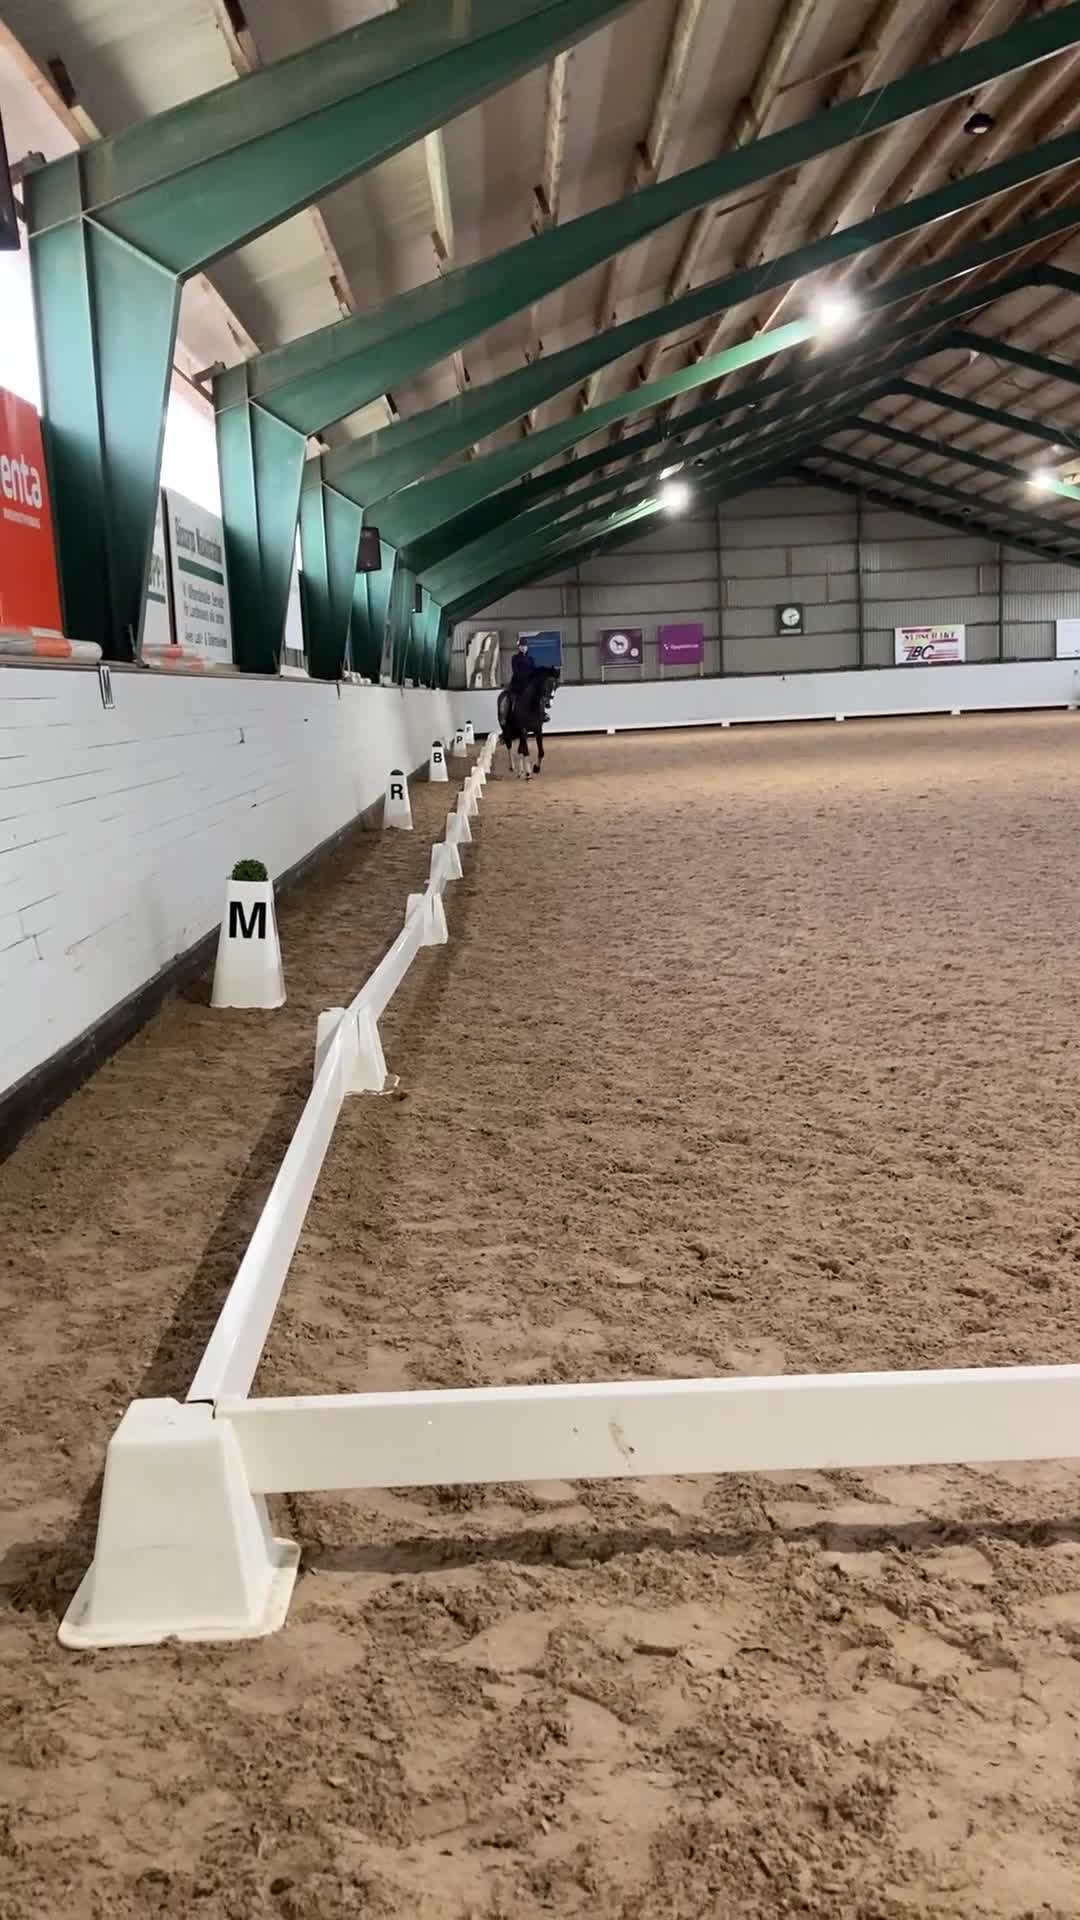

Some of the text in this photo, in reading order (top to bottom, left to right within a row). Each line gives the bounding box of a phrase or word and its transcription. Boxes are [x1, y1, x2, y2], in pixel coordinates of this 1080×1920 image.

[456, 735, 463, 744] P
[433, 752, 443, 763] B
[390, 784, 403, 801] R
[228, 901, 266, 940] M
